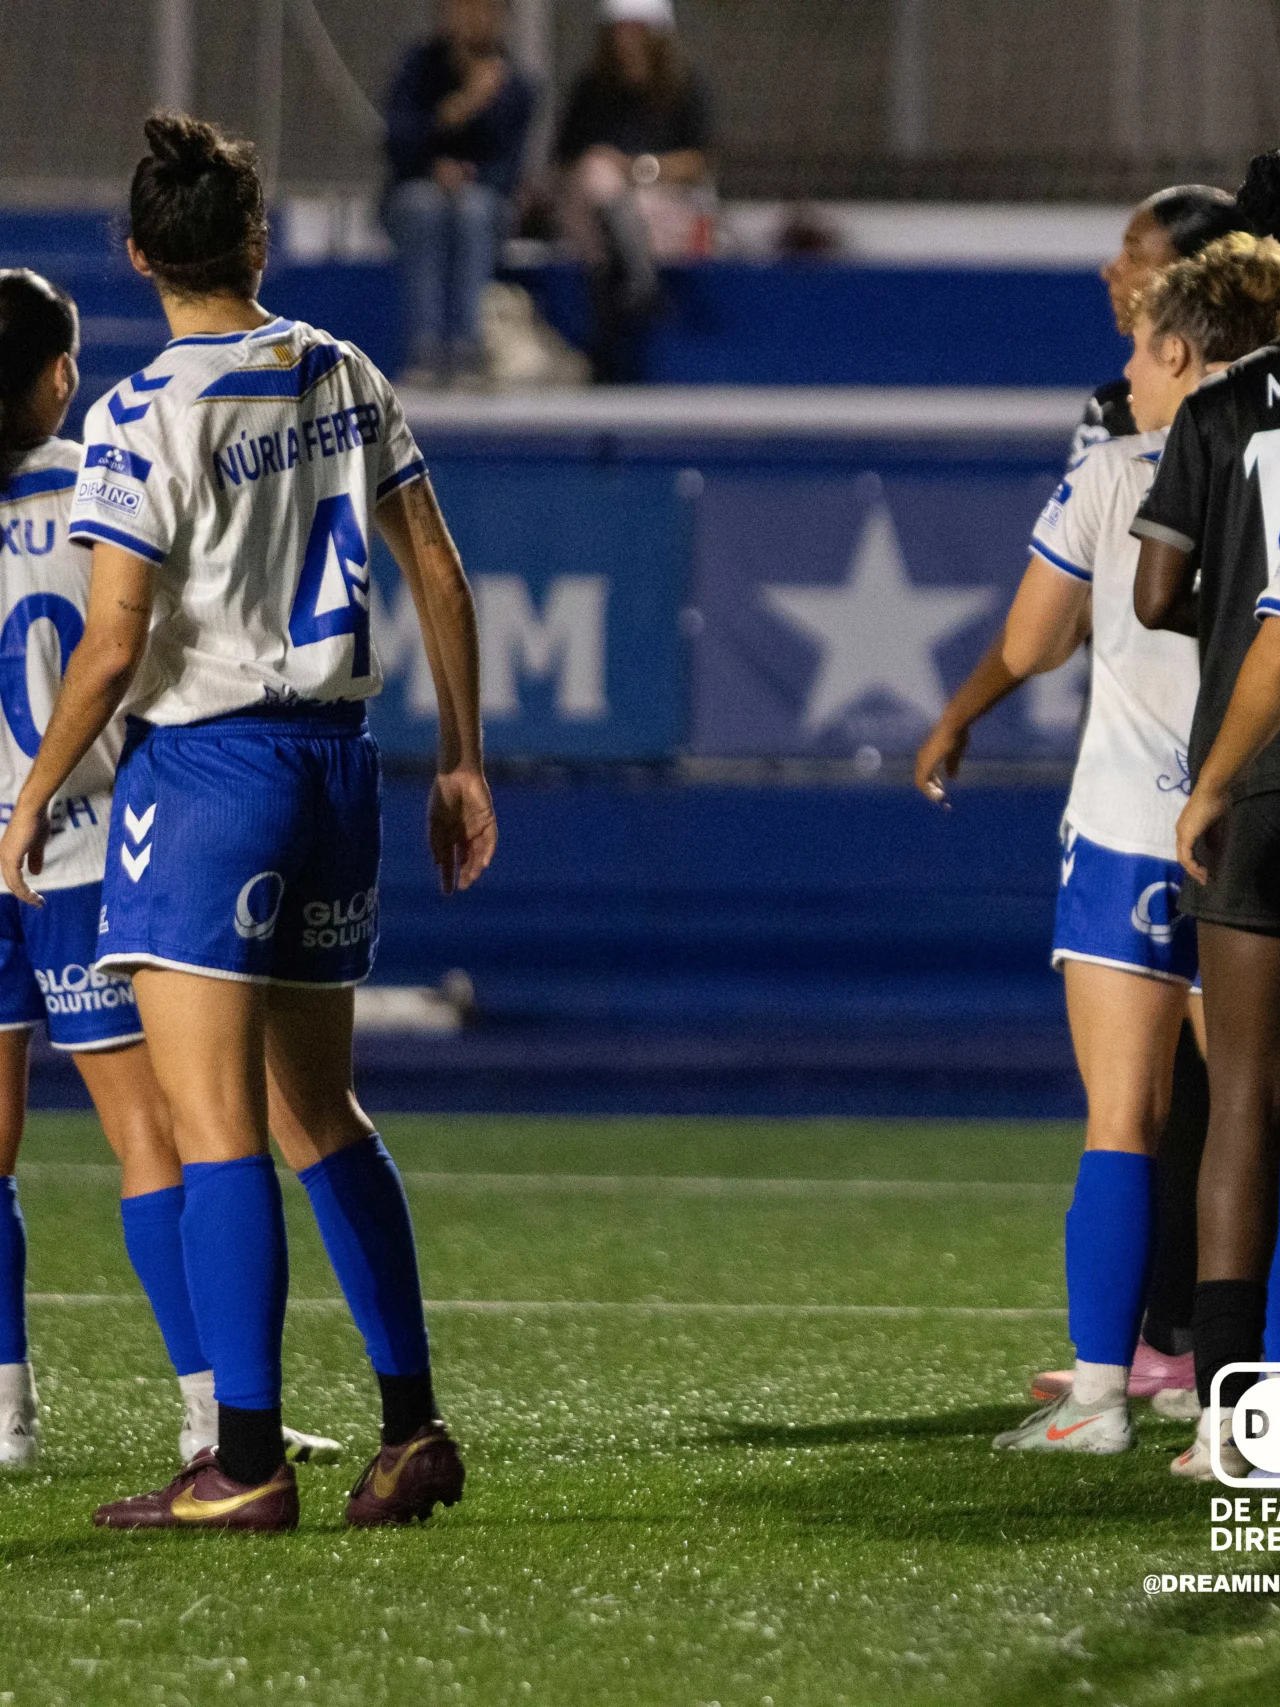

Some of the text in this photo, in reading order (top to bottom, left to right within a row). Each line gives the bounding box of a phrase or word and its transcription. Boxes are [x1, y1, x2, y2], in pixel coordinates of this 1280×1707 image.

[213, 402, 380, 491] NÚRIA FERRER
[110, 488, 138, 508] NO
[288, 492, 369, 679] 4
